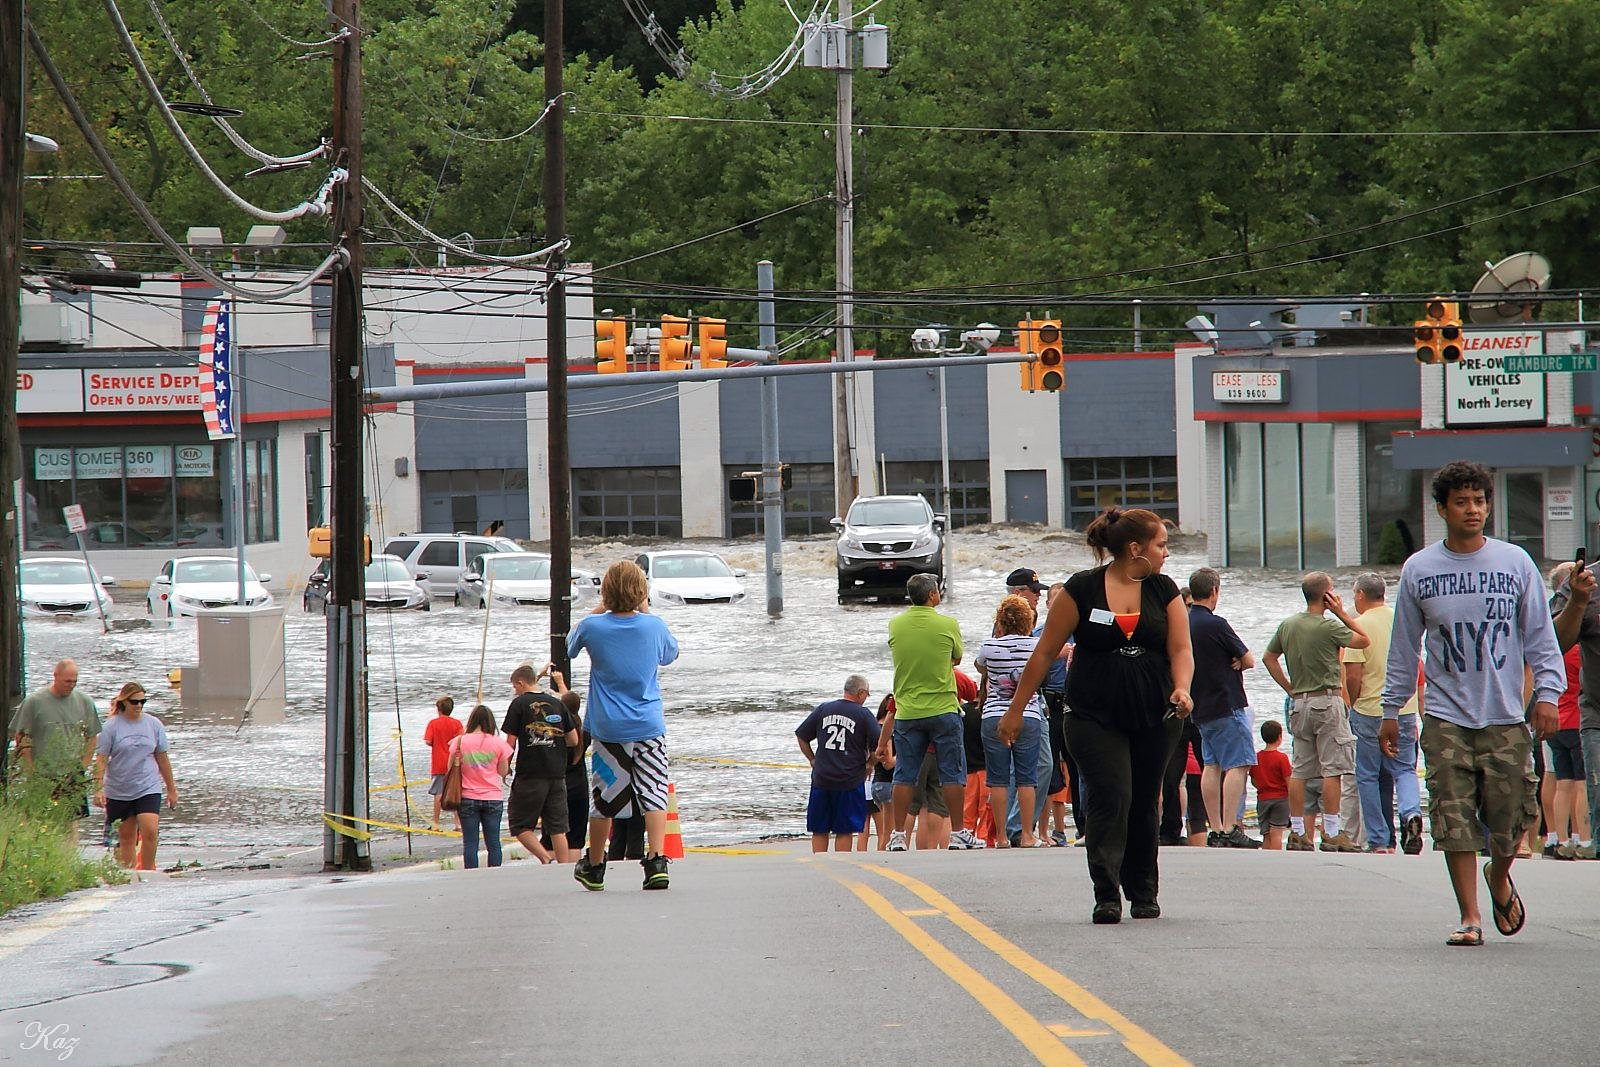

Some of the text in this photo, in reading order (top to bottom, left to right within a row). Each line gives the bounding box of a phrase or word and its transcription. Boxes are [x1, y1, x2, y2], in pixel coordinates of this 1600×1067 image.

[1463, 336, 1539, 351] LEANEST"
[1459, 358, 1505, 370] PRE-OW
[1508, 356, 1593, 371] HAMBURG TPK
[16, 374, 34, 390] ED
[91, 373, 155, 389] SERVICE
[1216, 374, 1242, 386] LEASE
[1256, 374, 1278, 386] LESS
[1468, 374, 1521, 387] VEHICLES
[90, 393, 199, 405] OPEN 6 DAYS/WEE
[1458, 397, 1533, 410] North Jersey
[128, 451, 154, 464] 360
[183, 450, 199, 458] KIA
[1418, 572, 1515, 600] CENTRAL PARK
[1485, 597, 1515, 620] ZOO
[1439, 621, 1510, 672] NYC
[825, 725, 846, 751] 24
